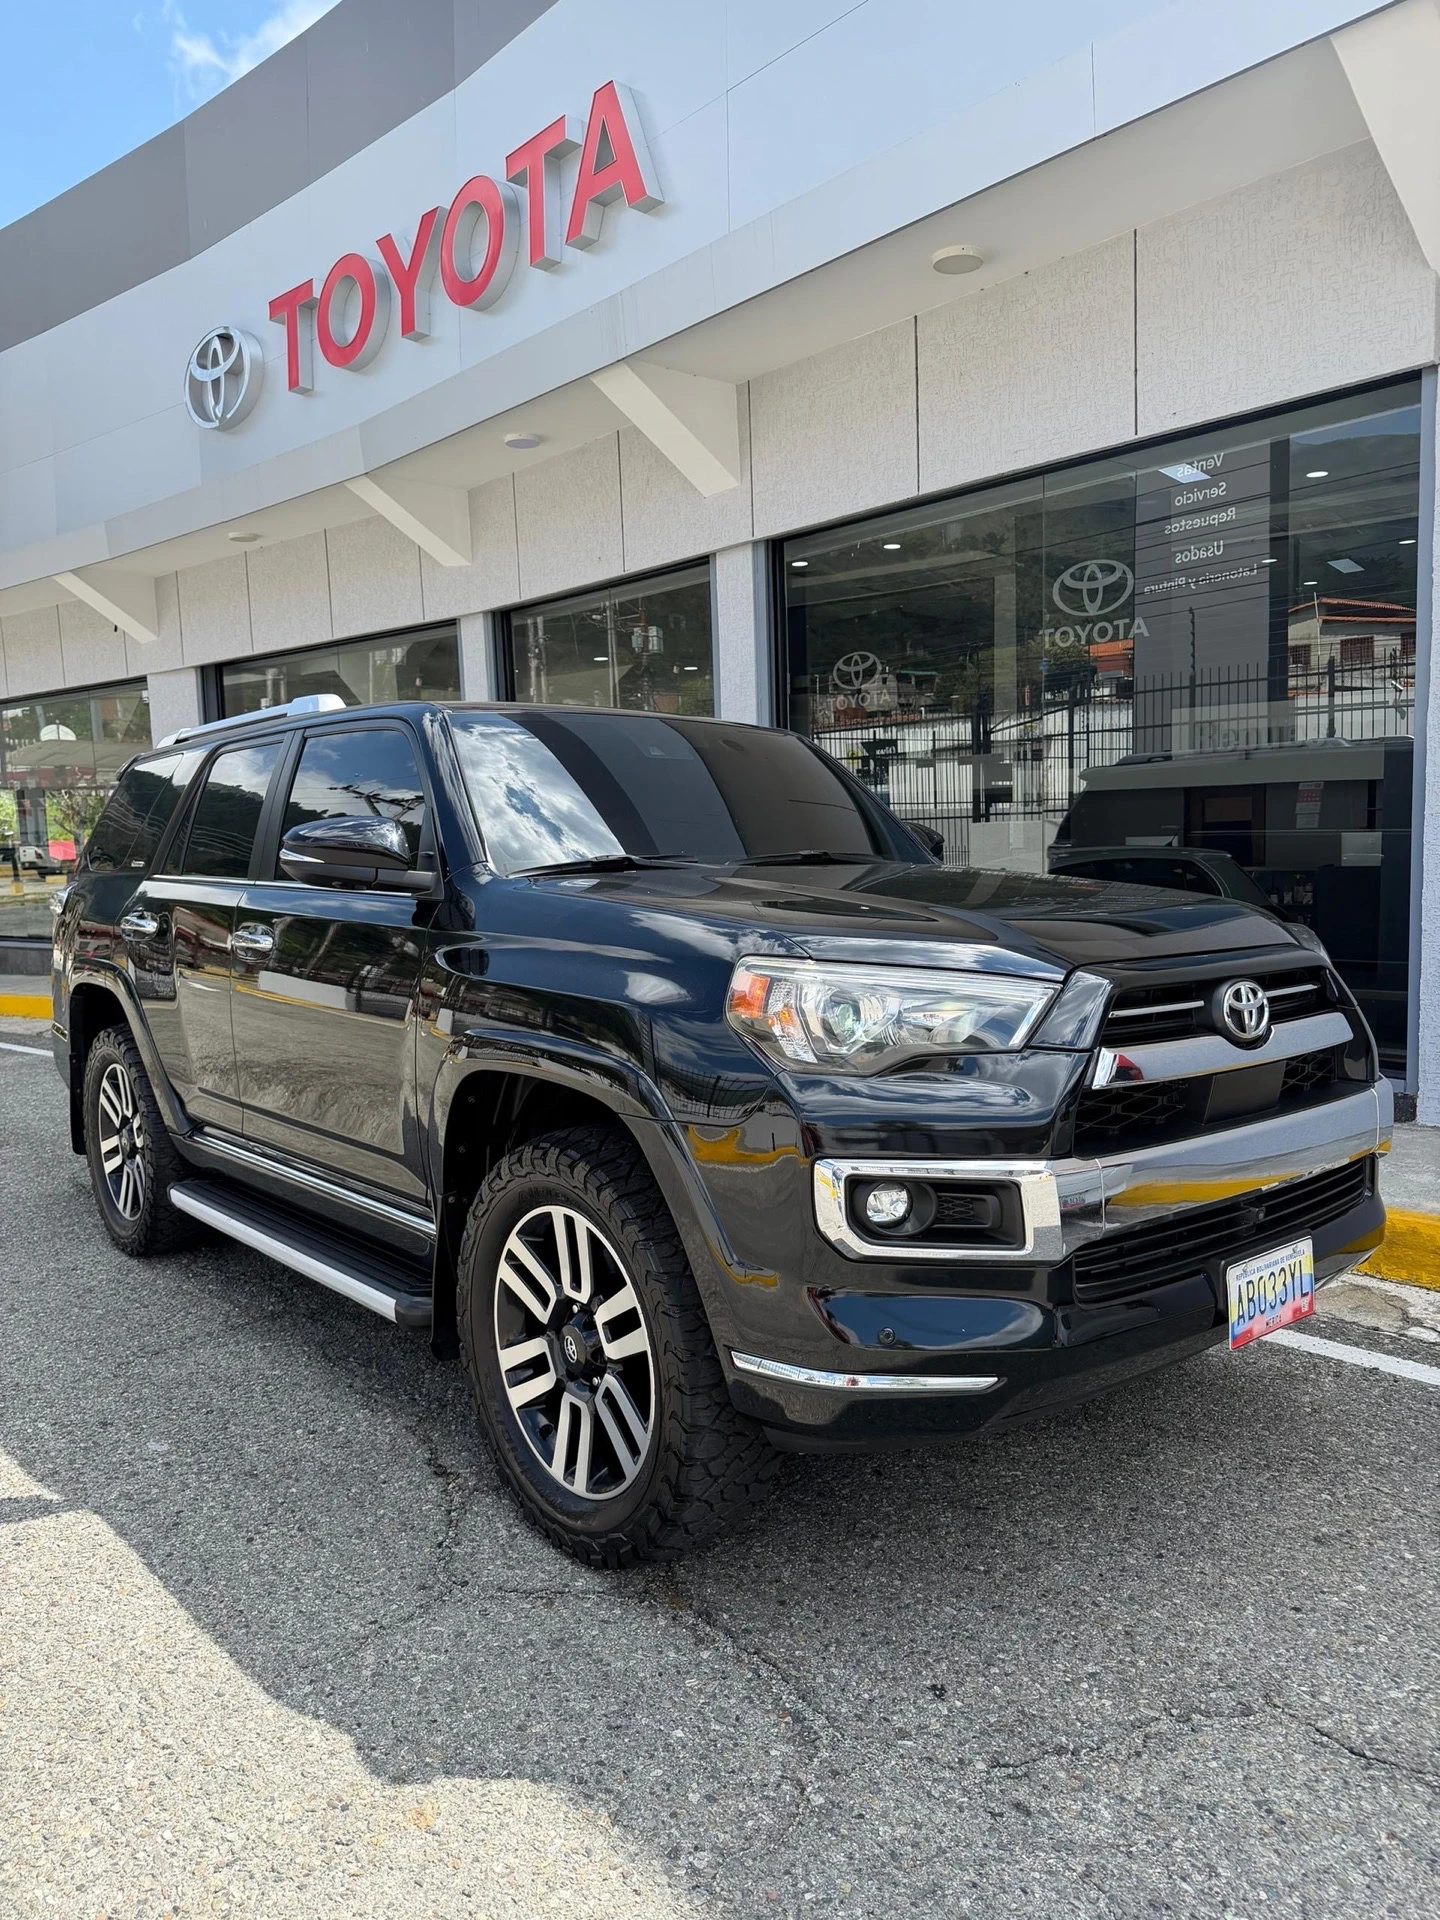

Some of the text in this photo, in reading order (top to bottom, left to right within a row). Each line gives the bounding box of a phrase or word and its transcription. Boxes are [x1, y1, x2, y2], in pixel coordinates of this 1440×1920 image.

[268, 79, 662, 394] TOYOTA
[1038, 616, 1150, 649] TOYOTA
[826, 689, 892, 712] TOYOTA
[1236, 1259, 1310, 1326] AB033YL
